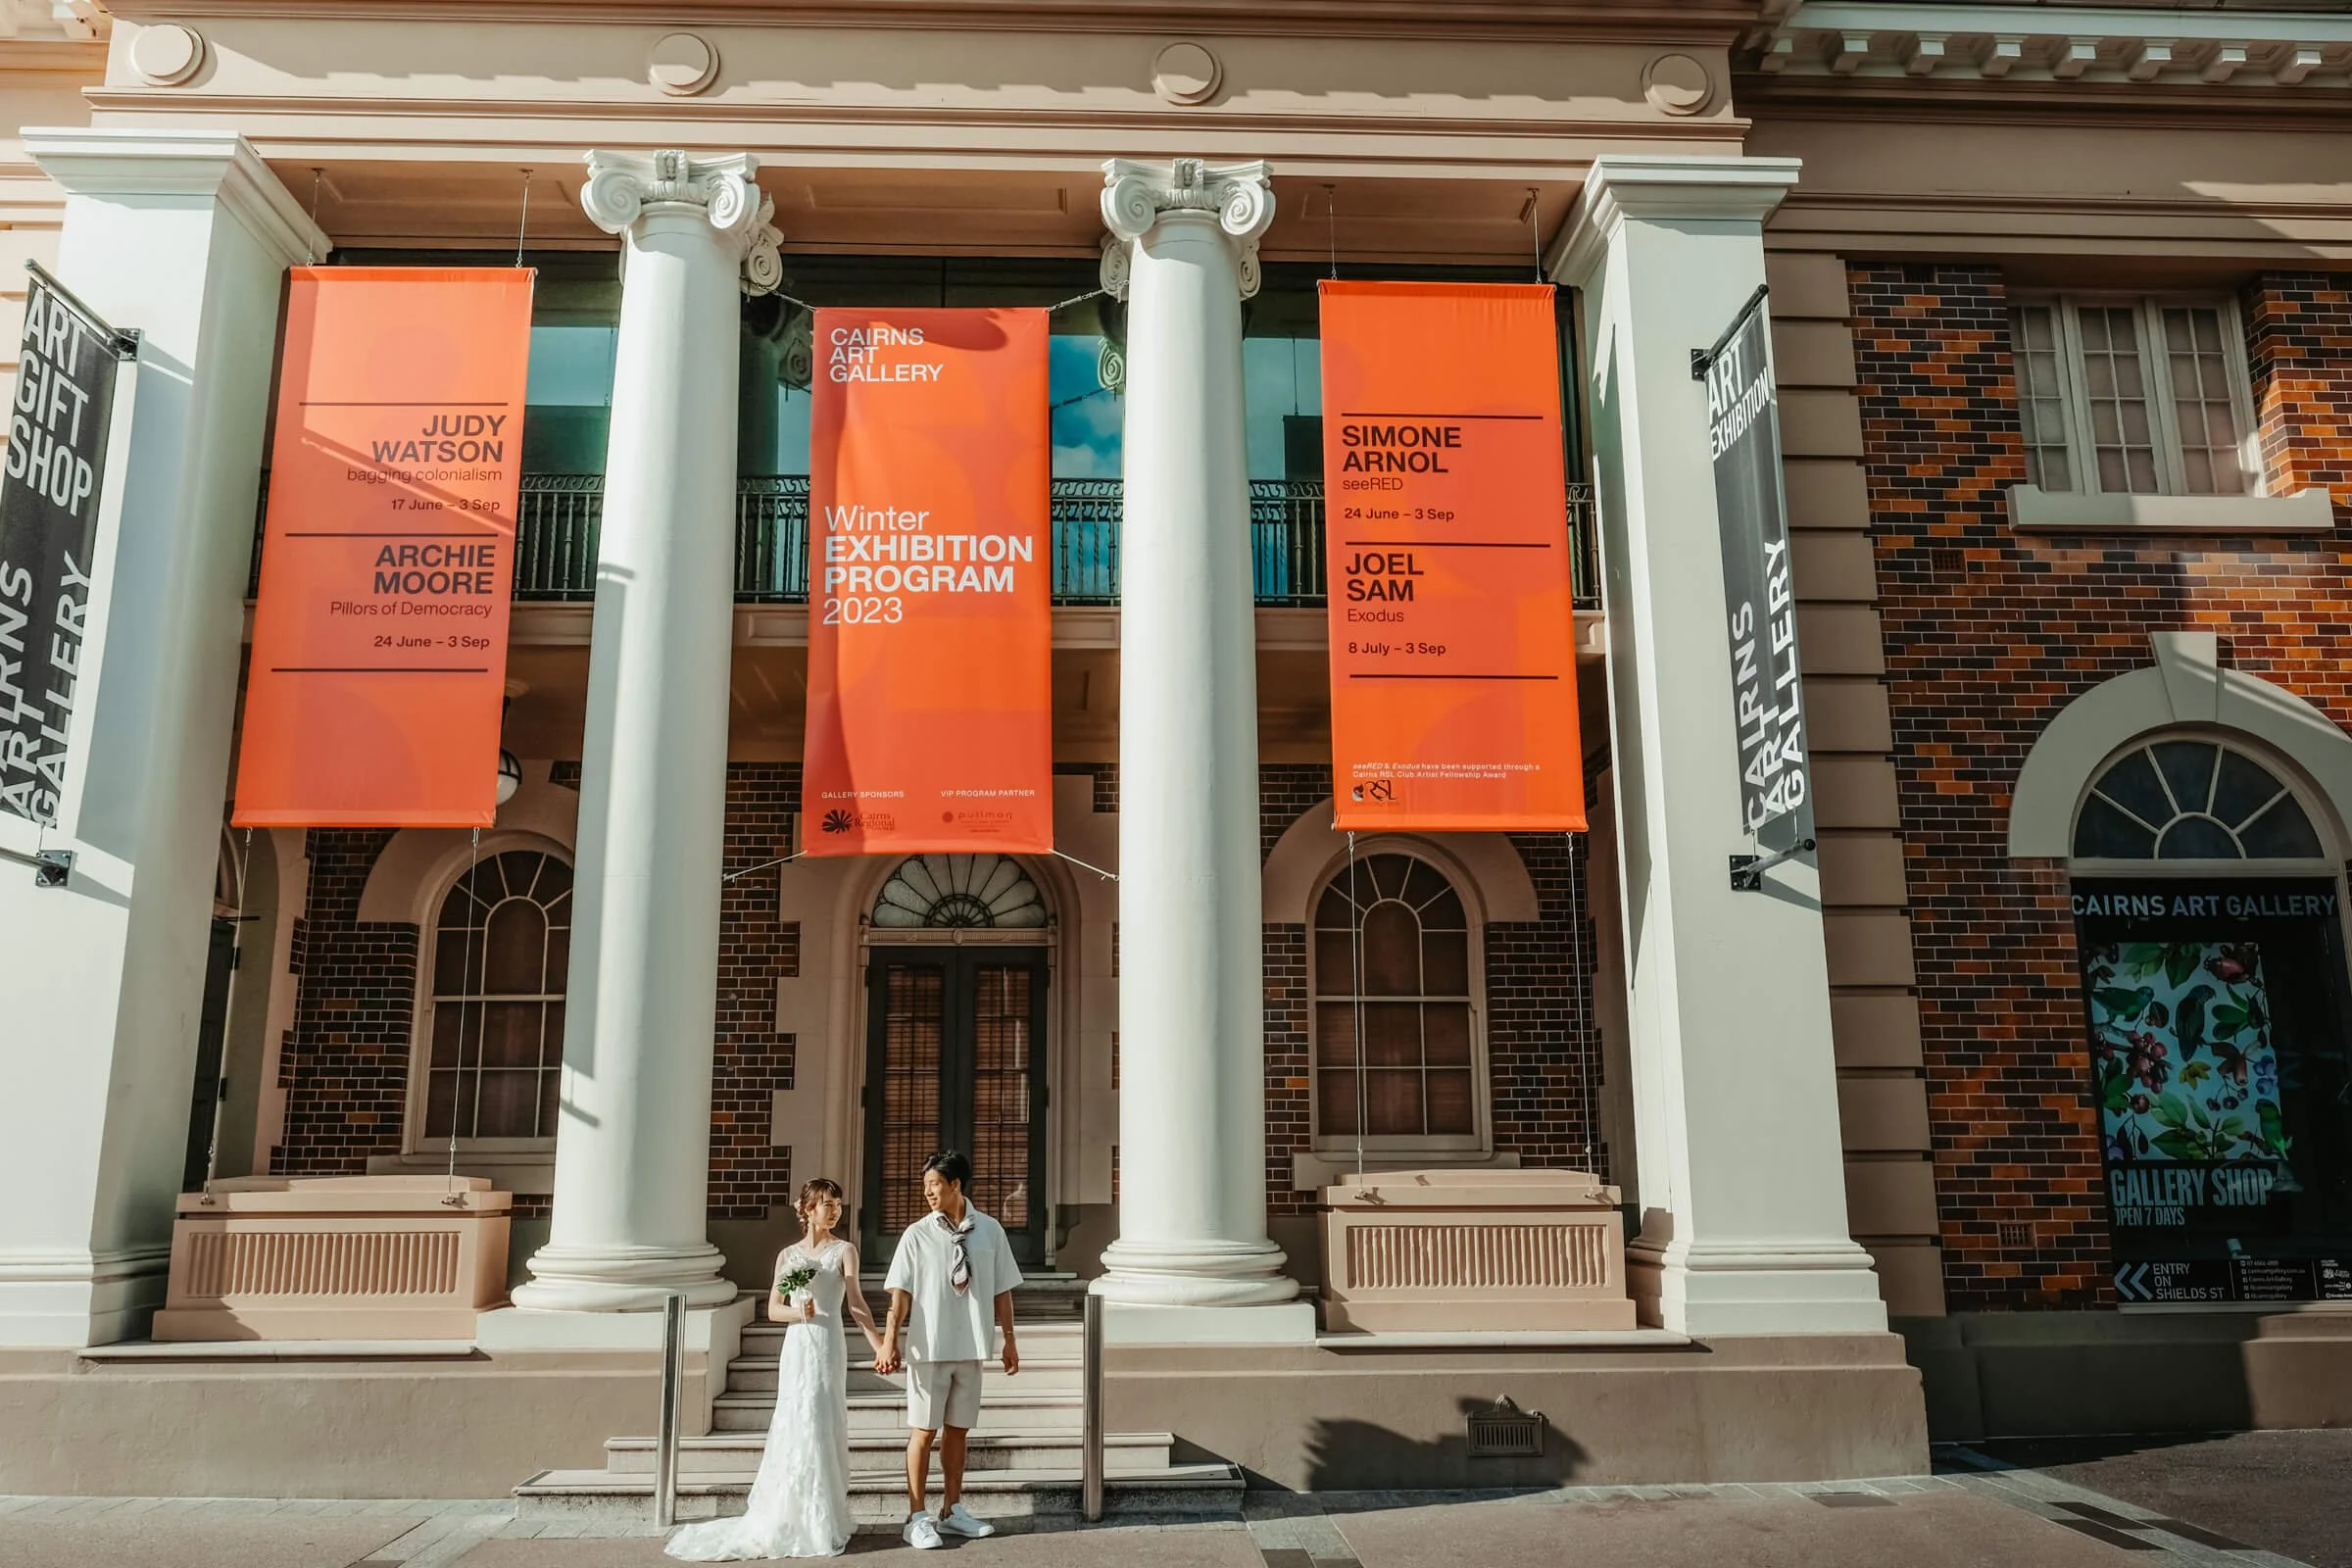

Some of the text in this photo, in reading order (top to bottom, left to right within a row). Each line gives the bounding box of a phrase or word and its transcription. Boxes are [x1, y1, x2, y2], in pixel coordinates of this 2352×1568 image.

[24, 286, 86, 376] ART
[830, 327, 924, 346] CAIRNS
[829, 346, 879, 365] ART
[829, 364, 945, 383] GALLERY
[1709, 336, 1743, 425] ART
[16, 350, 88, 448] GIFT
[1710, 367, 1769, 462] EXHIBITION
[421, 415, 507, 437] JUDY
[1342, 425, 1461, 448] SIMONE
[372, 440, 503, 463] WATSON
[1343, 451, 1448, 473] ARNOL
[7, 416, 92, 516] SHOP
[347, 467, 502, 484] bagging colonialism
[1343, 477, 1403, 491] seeRED
[392, 499, 405, 511] 17
[409, 499, 443, 511] June
[459, 499, 468, 511] 3
[472, 499, 501, 513] Sep
[1345, 508, 1361, 519] 24
[1366, 509, 1399, 519] June
[1415, 509, 1423, 519] 3
[1427, 509, 1454, 522] Sep
[825, 505, 930, 531] Winter
[374, 544, 496, 567] ARCHIE
[825, 535, 1033, 563] EXHIBITION
[1346, 553, 1424, 575] JOEL
[373, 571, 494, 595] MOORE
[824, 564, 1014, 594] PROGRAM
[1348, 579, 1414, 602] SAM
[381, 601, 398, 615] of
[401, 601, 493, 618] Democracy
[823, 597, 904, 625] 2023
[1348, 609, 1404, 622] Exodus
[374, 636, 392, 648] 24
[397, 636, 432, 648] June
[448, 636, 458, 648] 3
[461, 636, 490, 650] Sep
[1348, 642, 1357, 654] 8
[1362, 642, 1390, 656] July
[1405, 642, 1414, 654] 3
[1418, 642, 1446, 657] Sep
[1764, 538, 1804, 810] GALLERY
[29, 550, 89, 828] GALLERY
[1732, 601, 1766, 829] CAIRNS
[2, 689, 45, 818] ART
[1761, 703, 1786, 814] ART
[859, 790, 905, 799] SPONSORS
[2072, 895, 2335, 916] CAIRNS ART GALLERY
[2110, 1167, 2273, 1206] GALLERY SHOP
[2144, 1207, 2152, 1226] 7
[2156, 1207, 2185, 1226] DAYS
[2153, 1262, 2190, 1275] ENTRY
[2154, 1276, 2172, 1287] ON
[2156, 1288, 2225, 1299] SHIELDS ST
